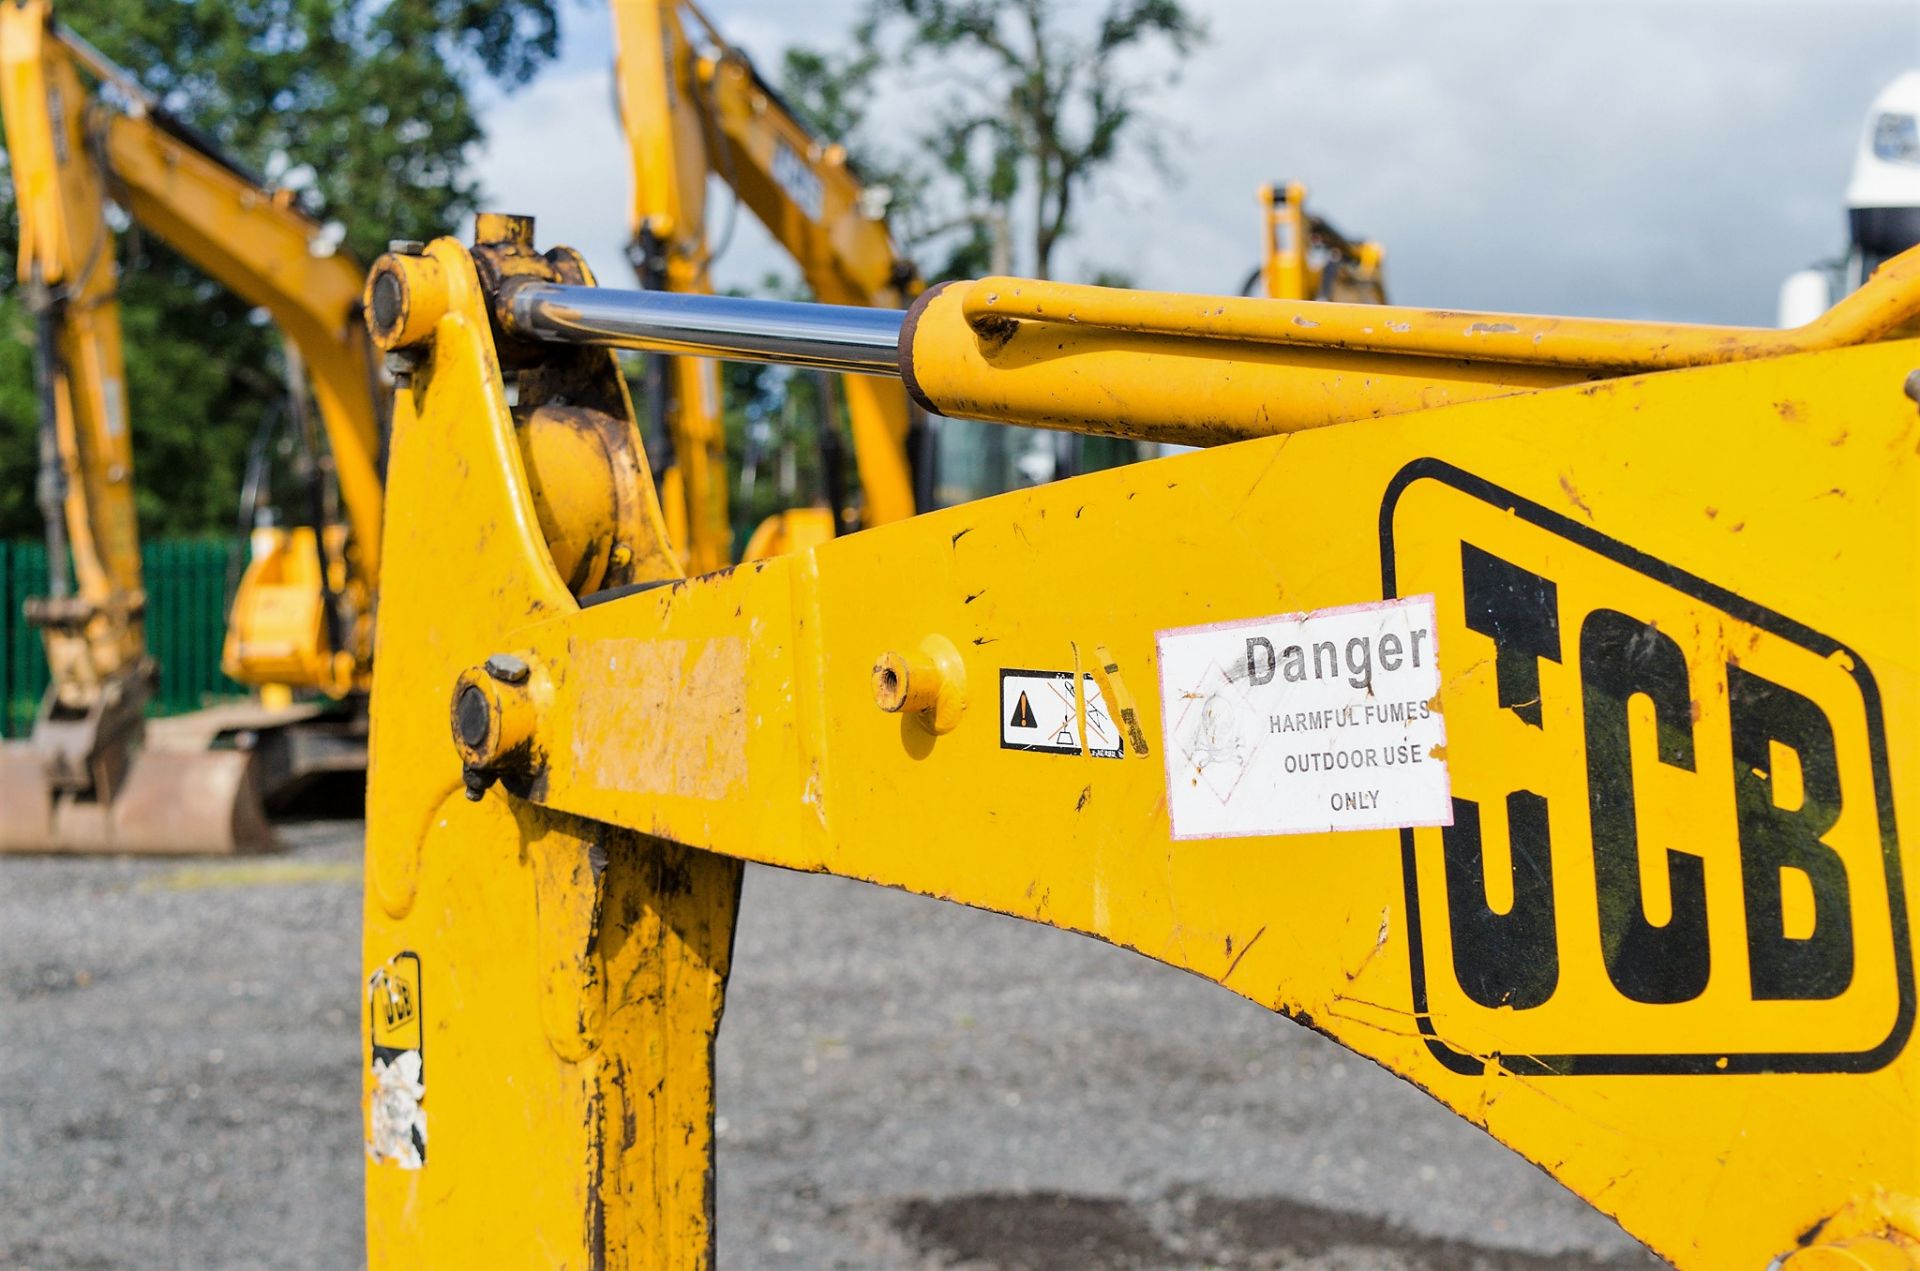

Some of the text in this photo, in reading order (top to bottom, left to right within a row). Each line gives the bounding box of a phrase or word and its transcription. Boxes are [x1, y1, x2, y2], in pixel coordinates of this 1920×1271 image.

[1246, 628, 1427, 689] Danger
[1269, 700, 1430, 733] HARMFUL FUMES
[1284, 744, 1422, 773] OUTDOOR USE
[1442, 540, 1854, 1010] JCB
[1331, 790, 1380, 811] ONLY
